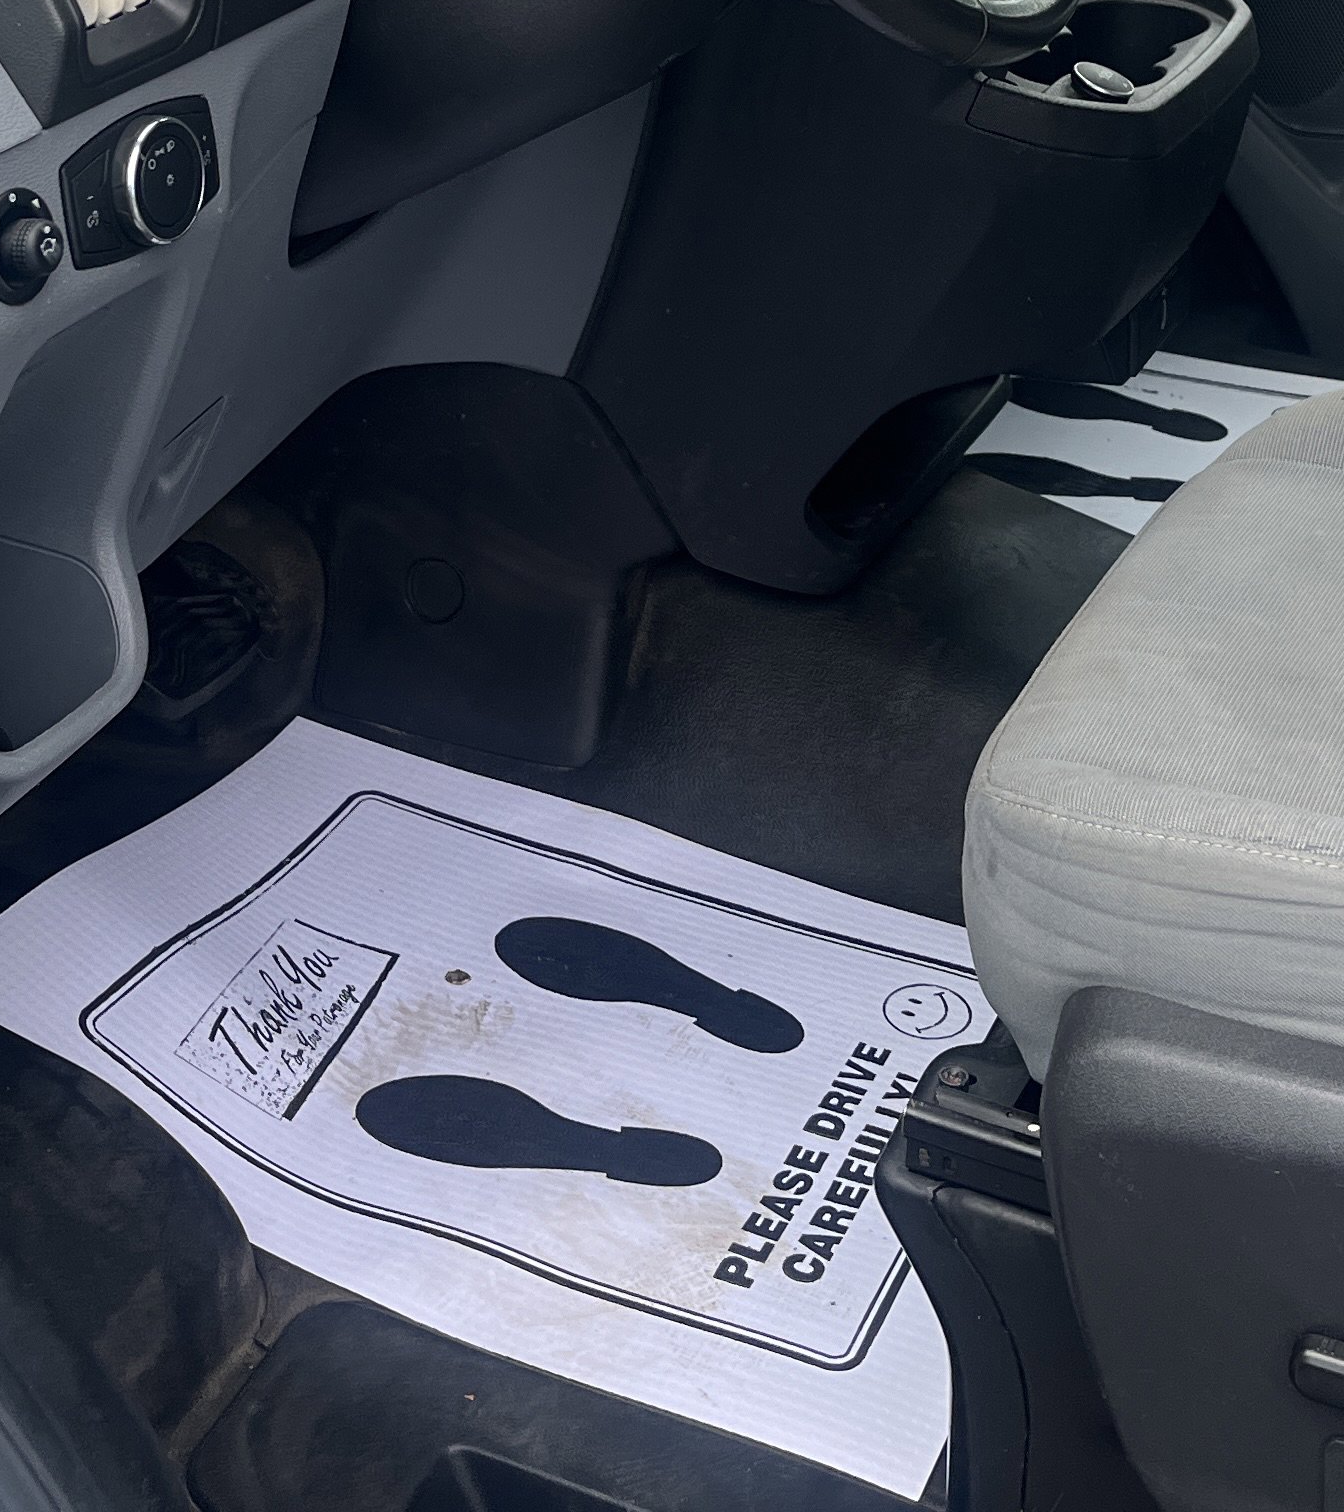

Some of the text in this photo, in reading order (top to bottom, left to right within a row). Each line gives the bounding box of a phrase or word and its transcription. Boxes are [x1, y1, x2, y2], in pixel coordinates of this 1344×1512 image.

[208, 944, 339, 1075] Thank You
[713, 1042, 892, 1289] PLEASE DRIVE
